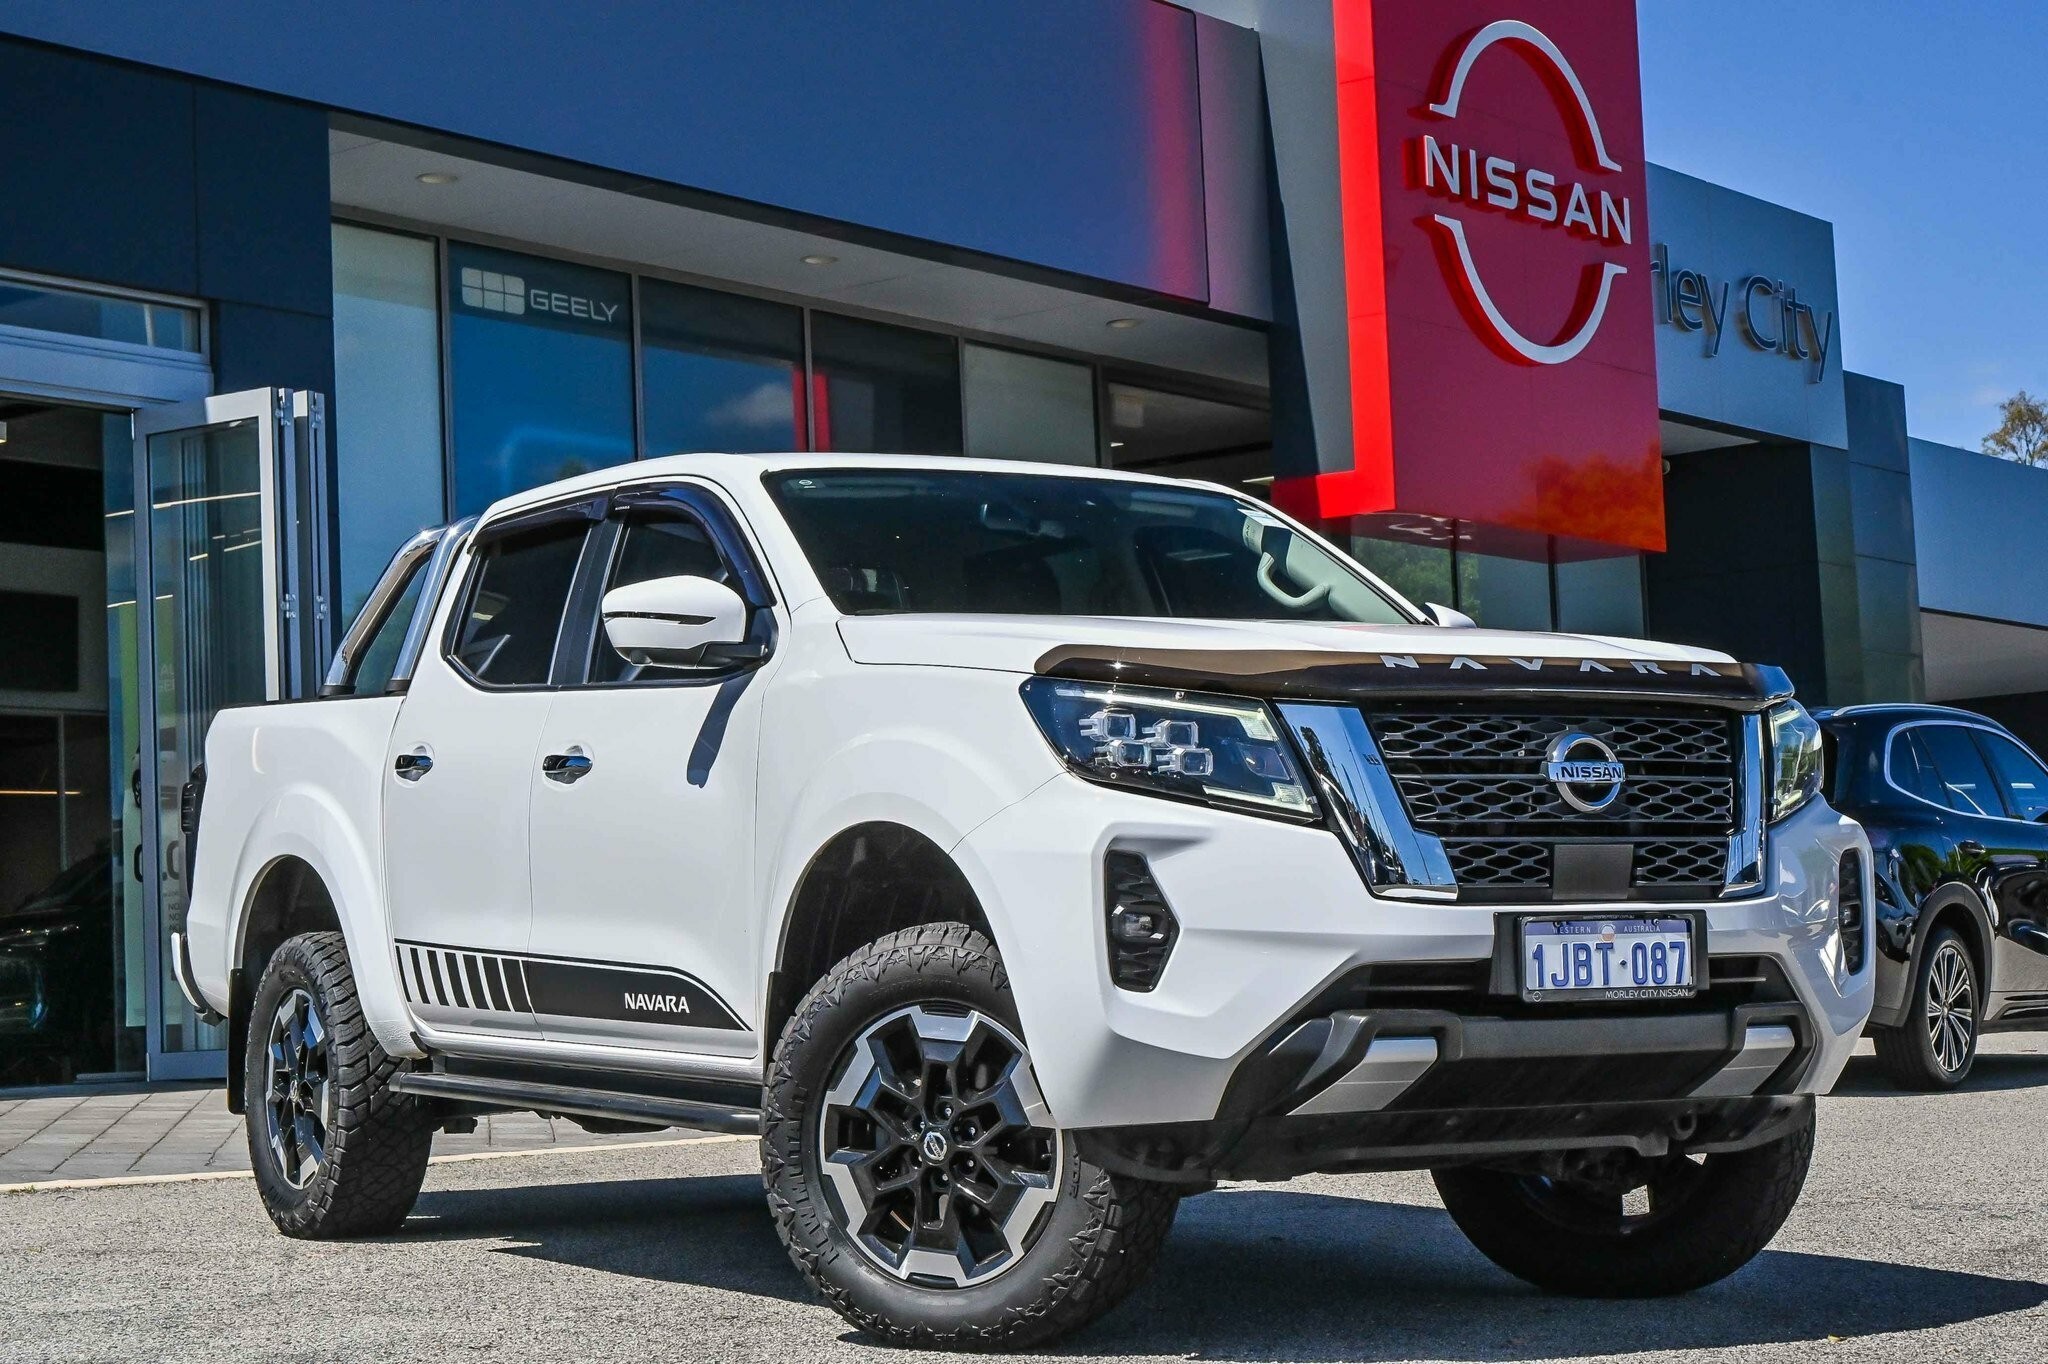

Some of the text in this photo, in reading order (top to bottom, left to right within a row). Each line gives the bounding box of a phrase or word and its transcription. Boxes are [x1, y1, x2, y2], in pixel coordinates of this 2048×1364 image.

[1424, 134, 1632, 245] NISSAN
[530, 289, 618, 322] GEELY
[1744, 275, 1833, 384] City
[1379, 654, 1722, 677] NAVARA
[1560, 766, 1622, 779] NISSAN
[1623, 925, 1661, 933] AUSTRALIA
[624, 992, 690, 1014] NAVARA
[1605, 988, 1689, 999] MORLEY CITY NISSAN
